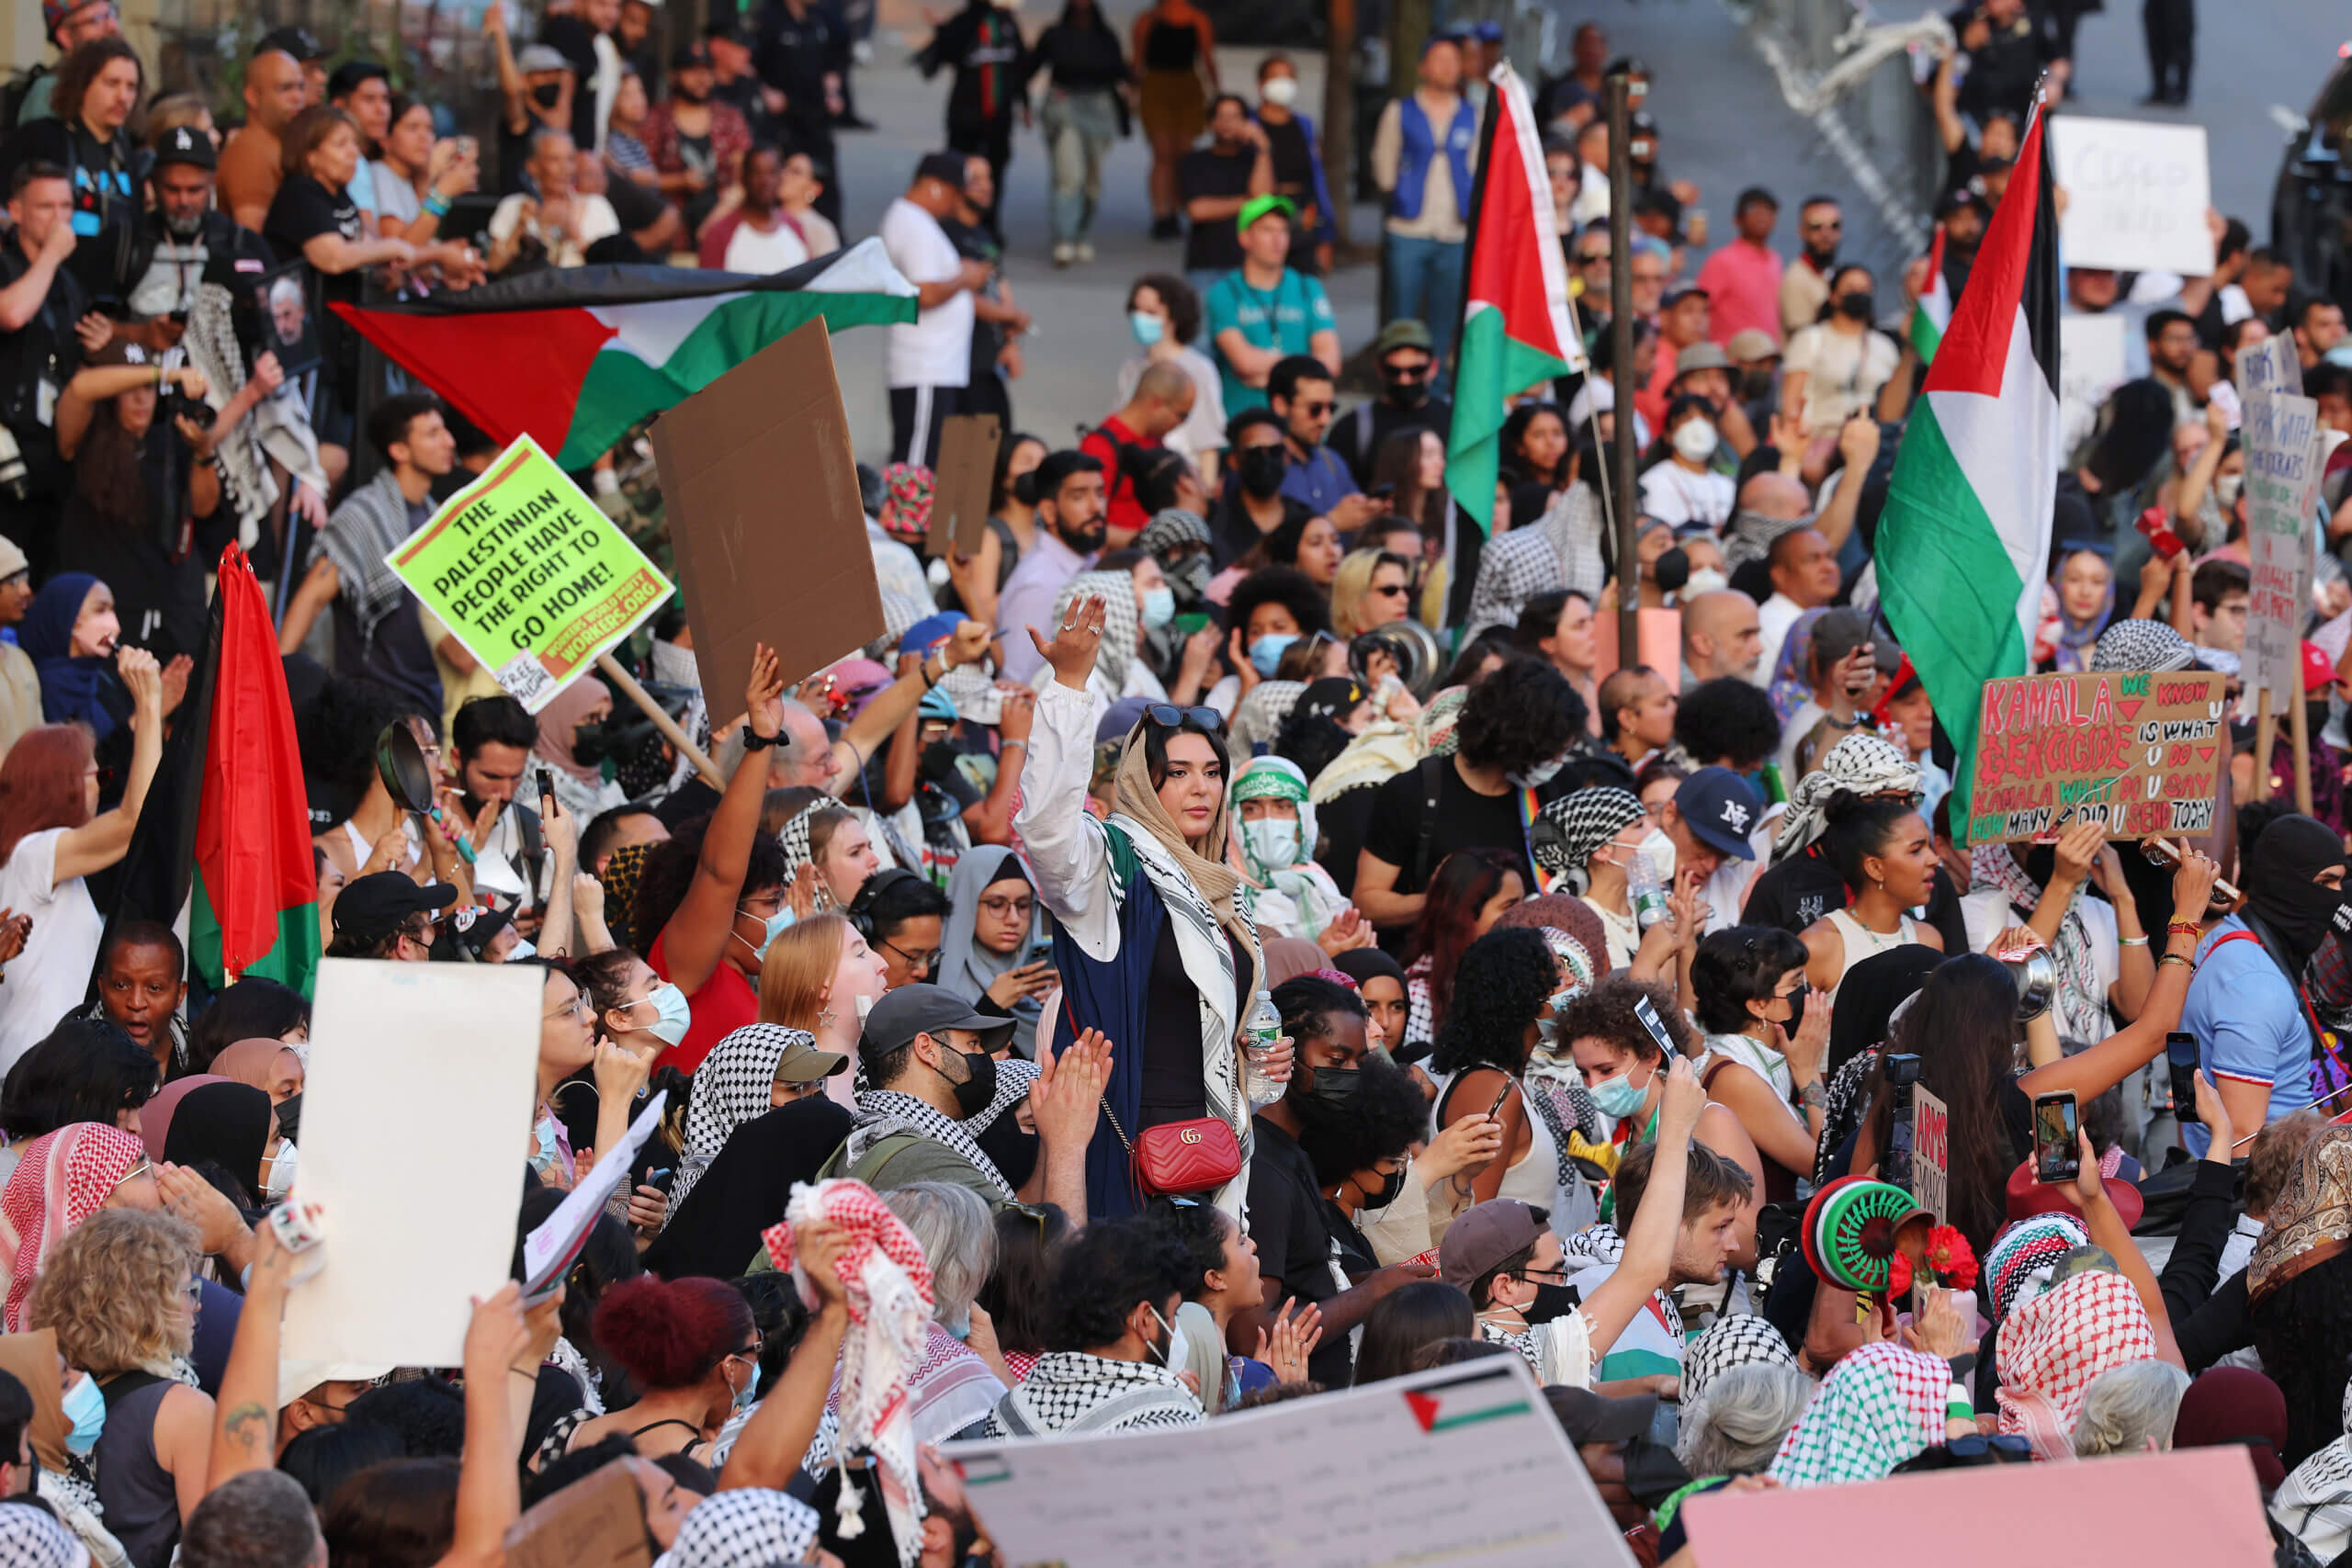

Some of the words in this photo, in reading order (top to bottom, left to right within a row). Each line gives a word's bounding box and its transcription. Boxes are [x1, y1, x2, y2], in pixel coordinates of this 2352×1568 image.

[434, 489, 560, 597] PALESTINIAN
[453, 500, 497, 536] THE
[450, 547, 527, 621] PEOPLE
[524, 508, 582, 555] HAVE
[474, 596, 514, 634] THE
[510, 551, 571, 604] RIGHT
[569, 529, 600, 557] TO
[510, 616, 545, 650] GO
[542, 560, 615, 619] HOME!
[560, 579, 658, 664] WORKERS.ORG
[588, 591, 616, 624] WORLD
[1984, 677, 2112, 734] KAMALA
[2121, 673, 2152, 696] WE
[2157, 682, 2210, 706] KNOW
[2209, 700, 2223, 719] U
[1979, 724, 2133, 788] GENOCIDE
[2139, 721, 2159, 744] IS
[2162, 719, 2221, 742] WHAT
[2146, 746, 2163, 767] U
[2168, 744, 2191, 768] DO
[1972, 812, 2006, 840] HOW
[2077, 805, 2109, 827] DID
[2113, 804, 2126, 834] U
[2127, 801, 2171, 834] SEND
[2171, 797, 2215, 830] TODAY
[1974, 783, 2052, 816] KAMALA
[2060, 777, 2117, 805] WHAT
[2120, 776, 2141, 801] DO
[2146, 774, 2162, 799] U
[2164, 773, 2211, 798] SAY
[1916, 1100, 1947, 1172] ARMS
